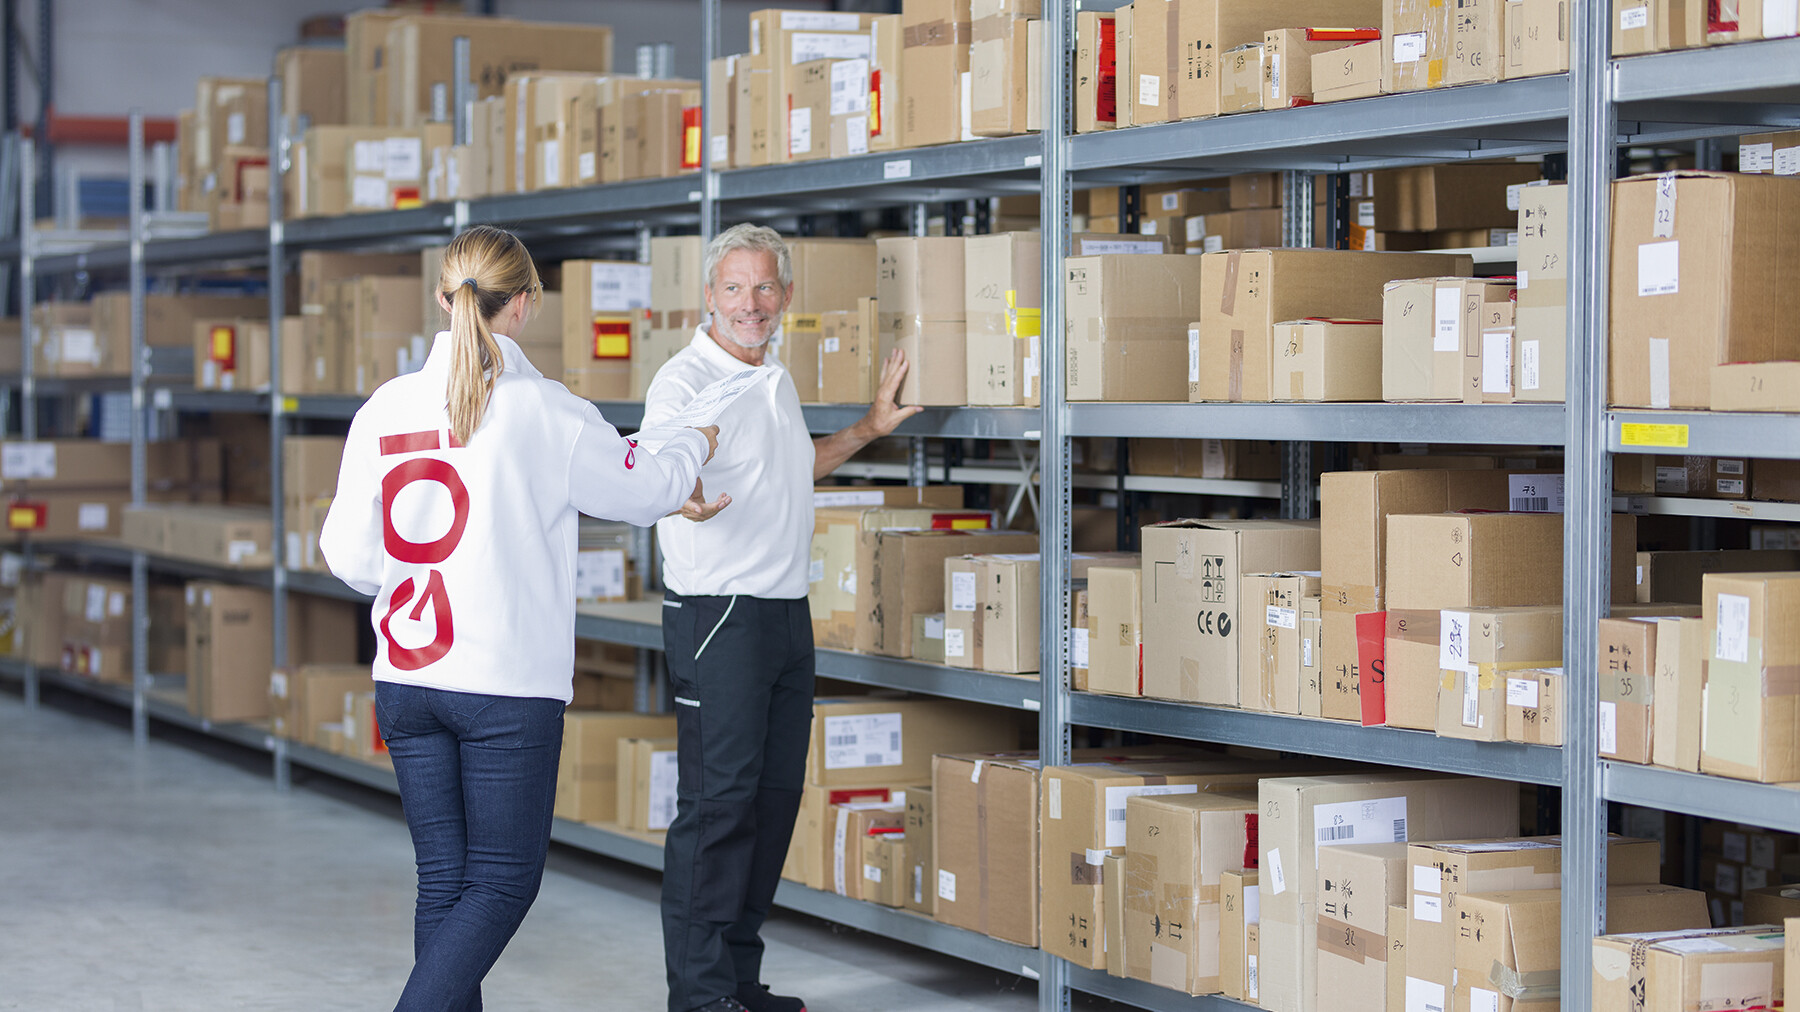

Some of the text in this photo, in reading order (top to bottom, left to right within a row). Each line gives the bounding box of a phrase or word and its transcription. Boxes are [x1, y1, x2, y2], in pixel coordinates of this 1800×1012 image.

[1470, 51, 1481, 66] CE
[1658, 208, 1670, 224] 22
[1541, 253, 1559, 271] 58
[1522, 485, 1536, 496] 73
[1197, 609, 1213, 635] CE
[1482, 622, 1490, 638] CE
[1621, 677, 1633, 697] 35
[1266, 800, 1280, 819] 83
